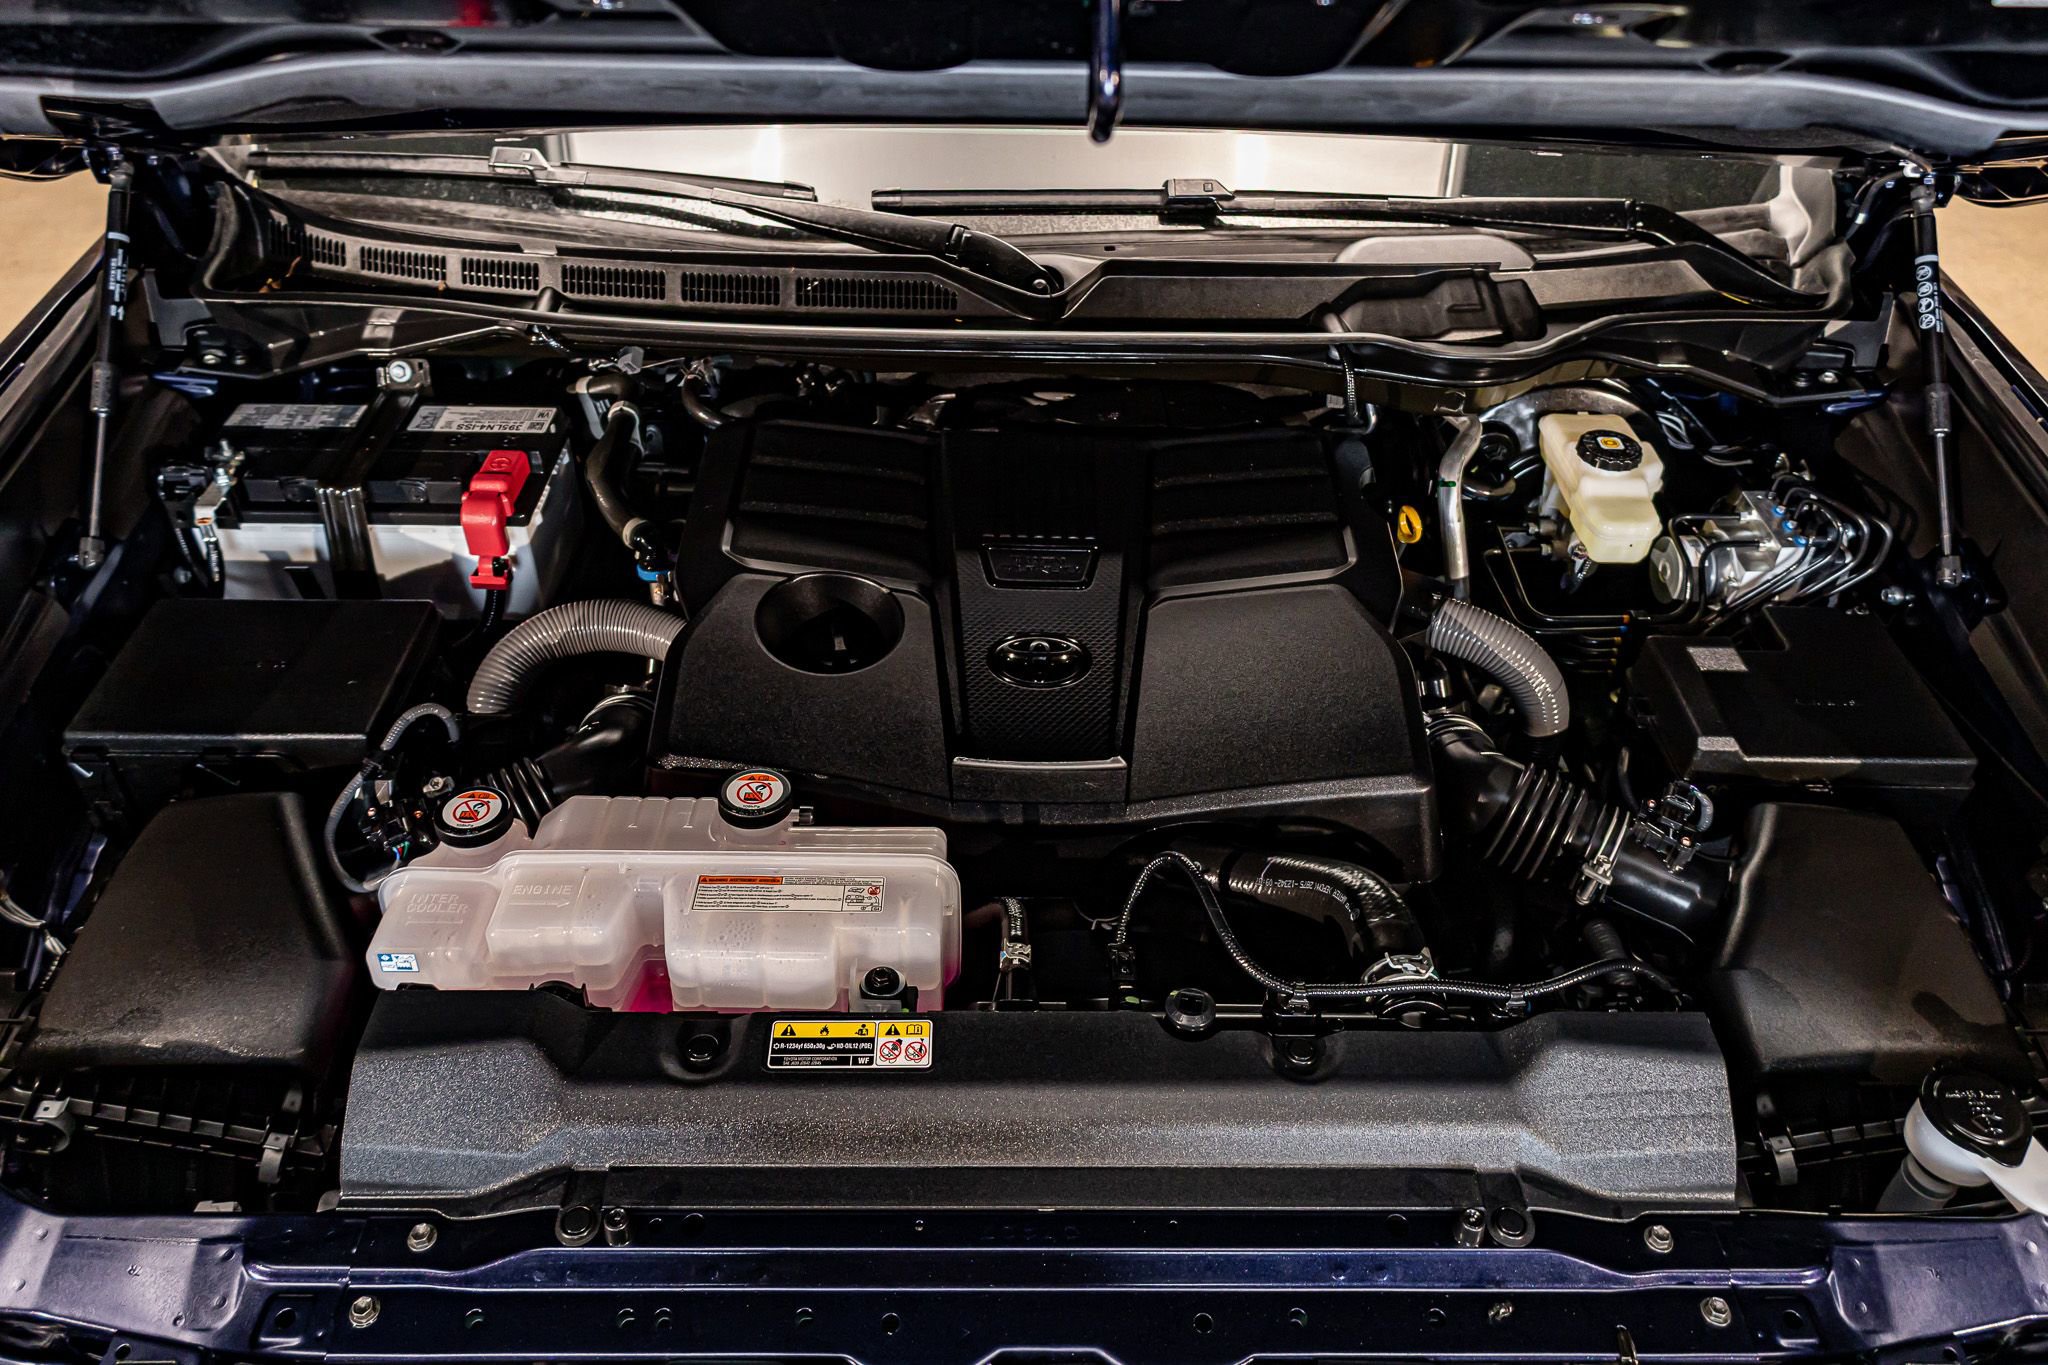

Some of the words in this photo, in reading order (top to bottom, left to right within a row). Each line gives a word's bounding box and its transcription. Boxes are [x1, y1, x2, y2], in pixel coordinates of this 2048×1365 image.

[455, 423, 523, 431] 395LN4-ISS
[511, 884, 574, 895] ENGINE
[410, 893, 460, 903] INTER
[406, 903, 470, 913] COOLER
[857, 1057, 870, 1065] WF
